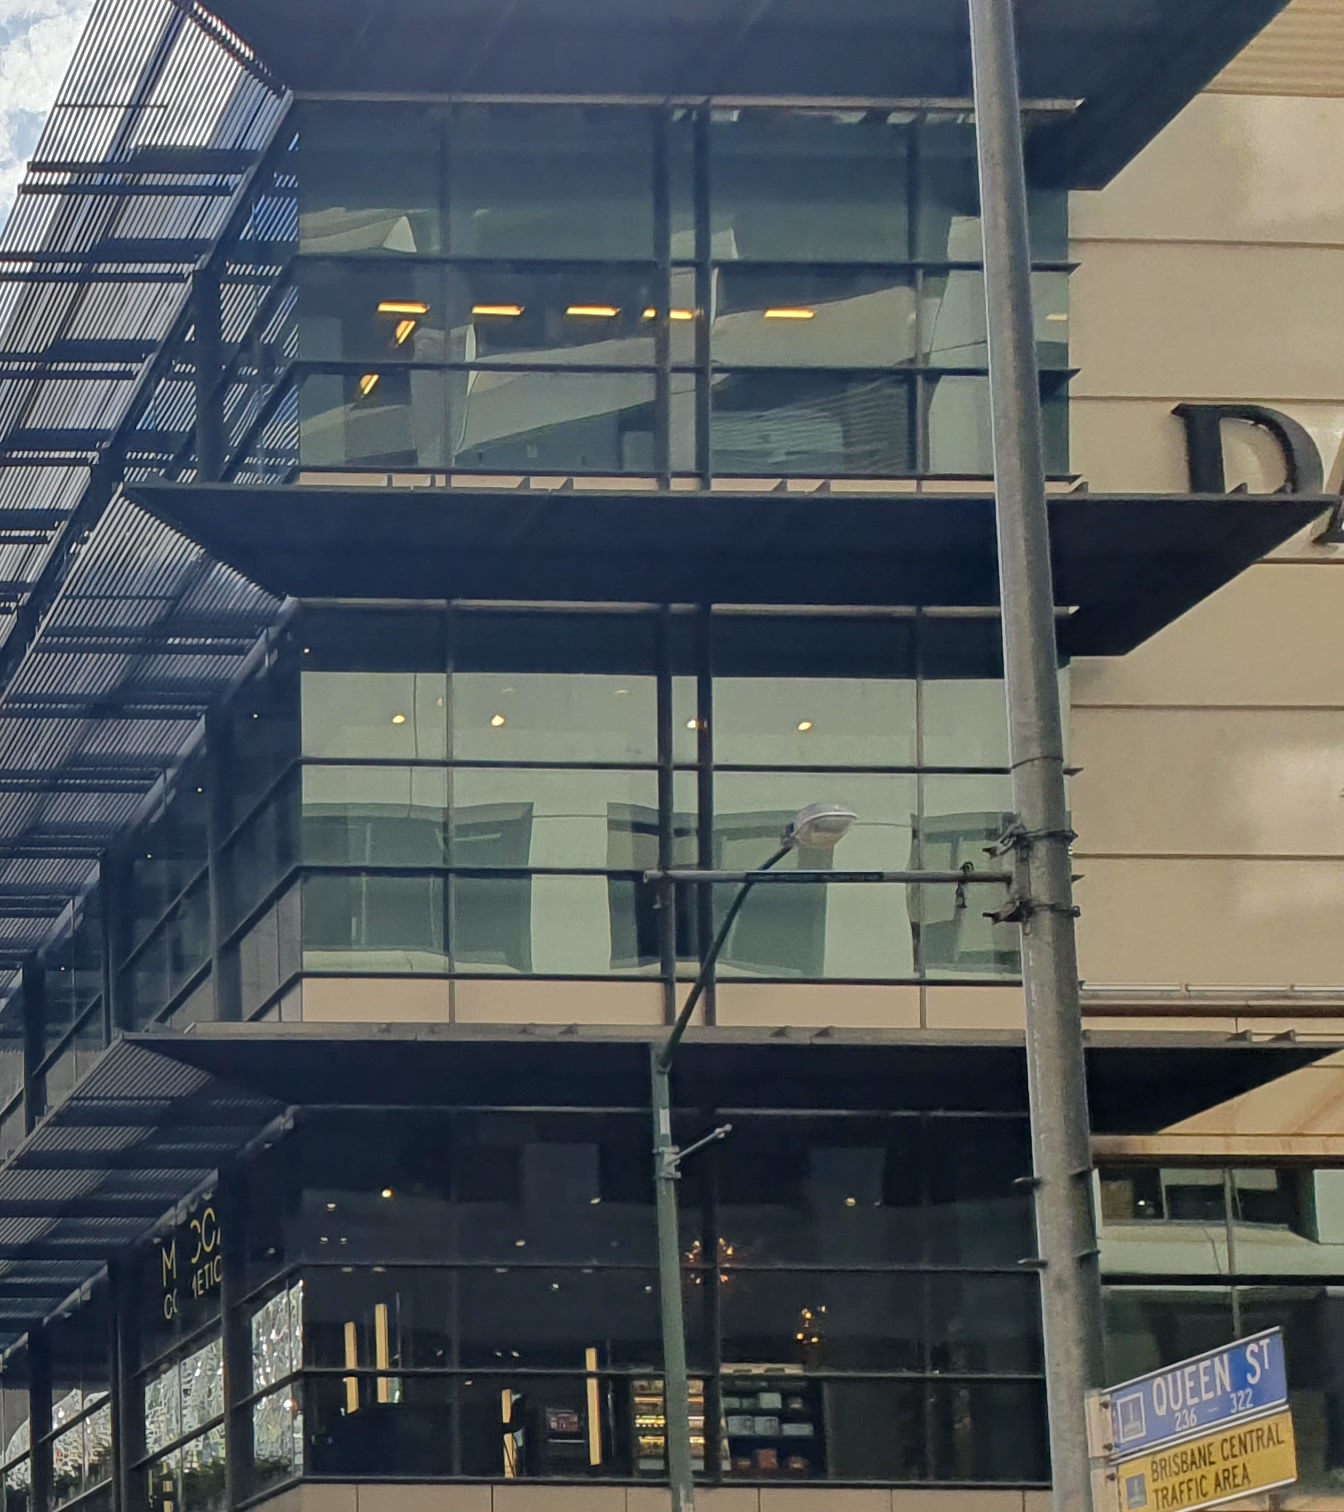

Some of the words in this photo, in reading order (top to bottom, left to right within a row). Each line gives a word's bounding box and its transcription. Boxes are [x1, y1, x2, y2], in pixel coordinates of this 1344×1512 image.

[1152, 1353, 1232, 1416] QUEEN
[1245, 1338, 1271, 1385] ST
[1174, 1407, 1198, 1432] 236
[1229, 1388, 1254, 1414] 322
[1150, 1443, 1216, 1483] BRISBANE
[1220, 1422, 1285, 1462] CENTRAL
[1152, 1474, 1209, 1511] TRAFFIC
[1213, 1462, 1251, 1493] AREA
